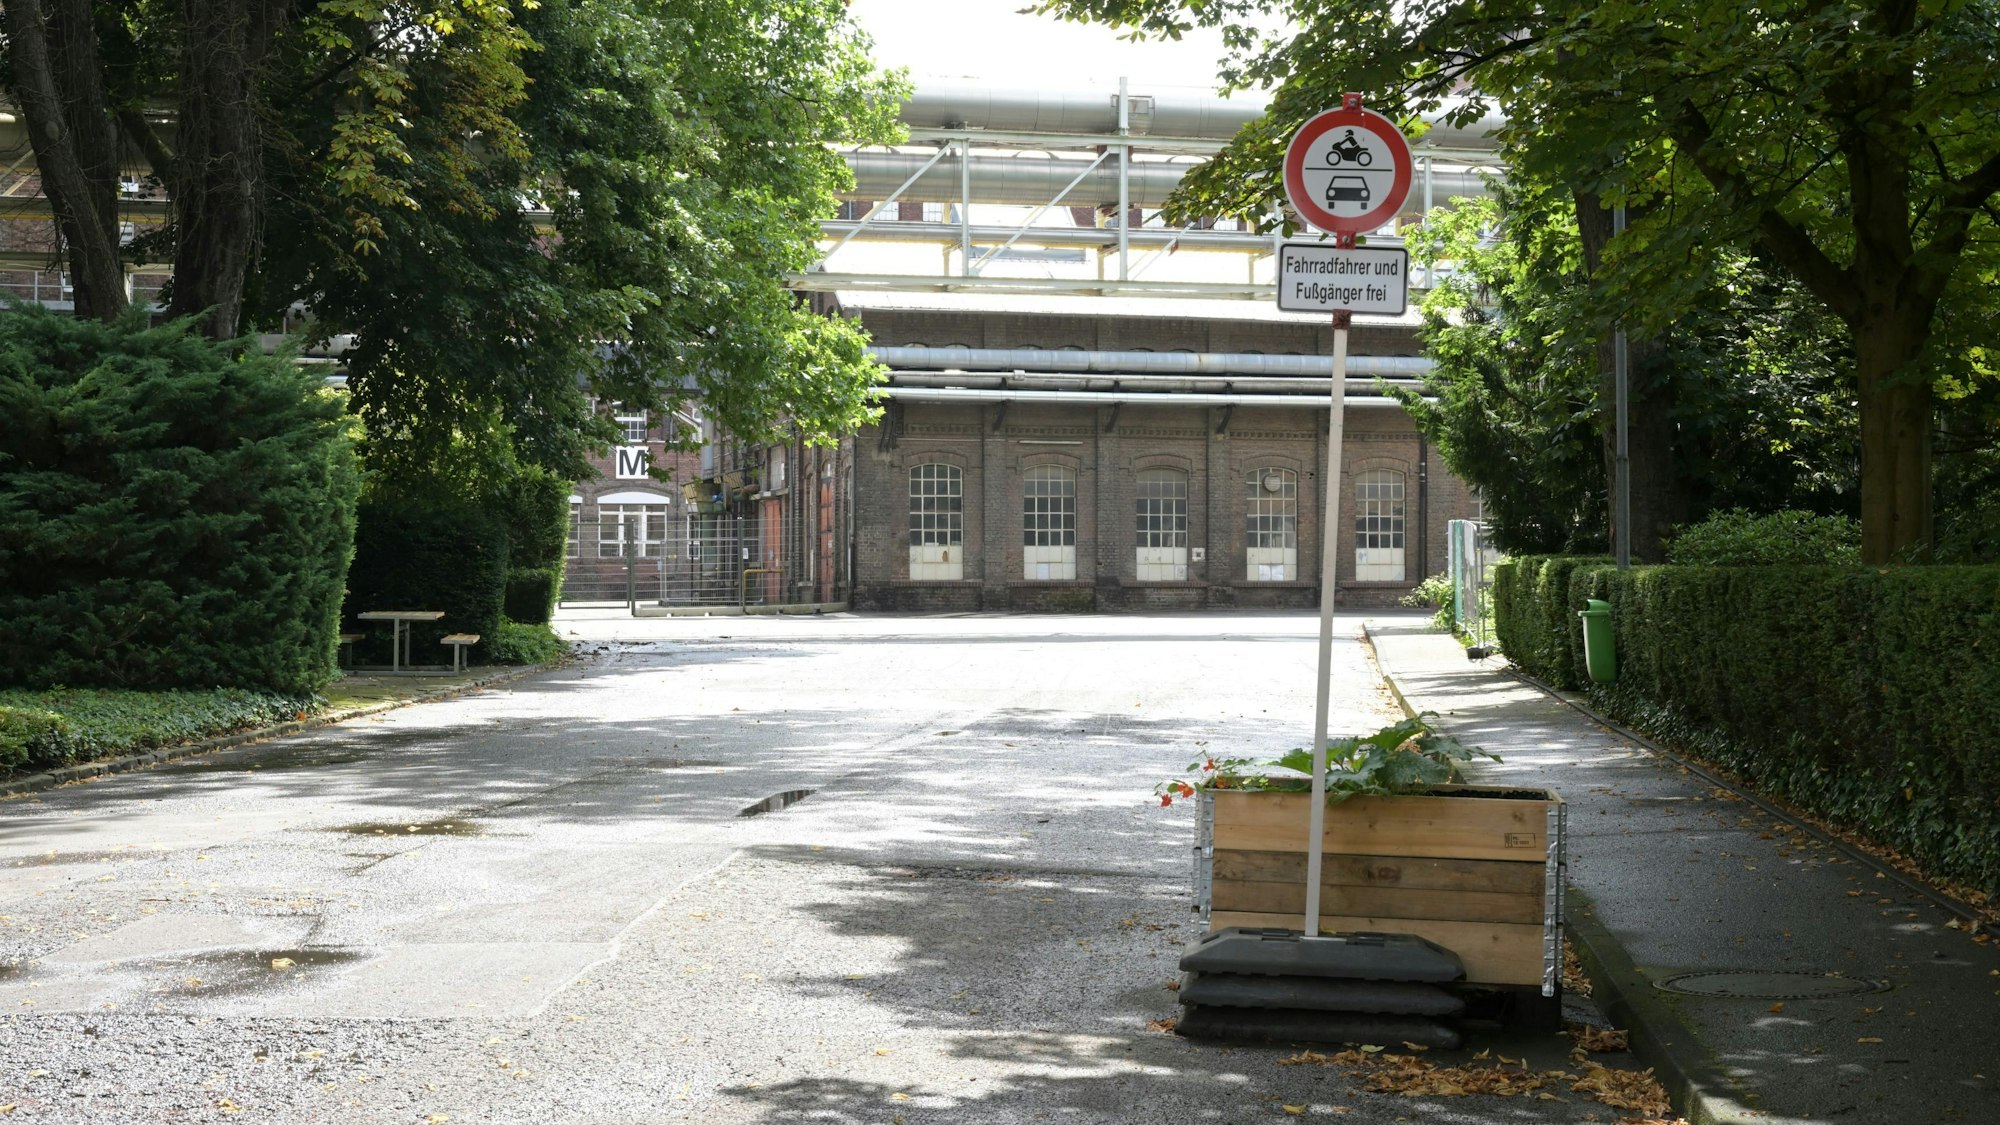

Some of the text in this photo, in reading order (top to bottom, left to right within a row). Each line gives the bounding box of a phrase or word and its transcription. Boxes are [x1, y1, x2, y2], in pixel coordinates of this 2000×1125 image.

[1286, 256, 1398, 276] Fahrradfahrer und
[1296, 282, 1387, 305] Fußgänger frei
[619, 449, 646, 476] M
